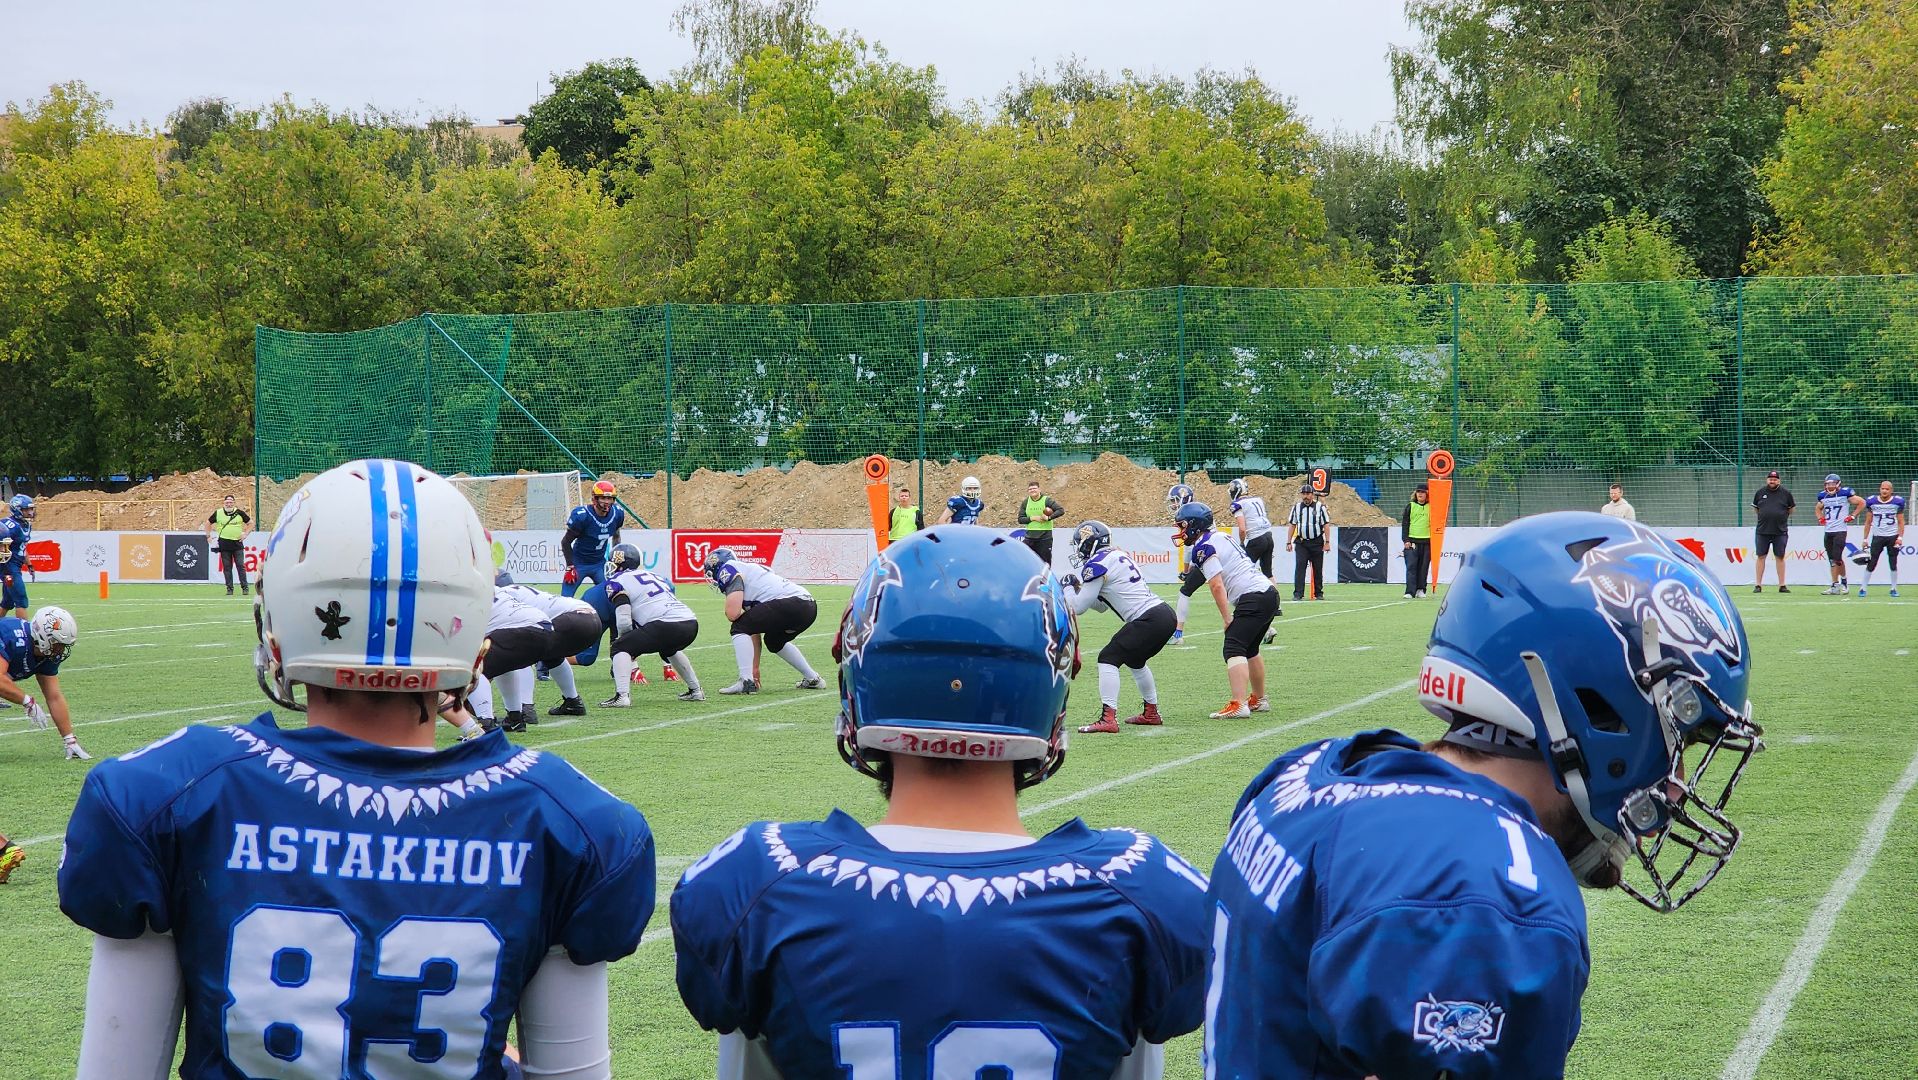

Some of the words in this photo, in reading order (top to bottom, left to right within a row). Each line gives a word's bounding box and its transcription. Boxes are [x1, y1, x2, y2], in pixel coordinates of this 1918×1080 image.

[1312, 468, 1327, 491] 3
[1872, 512, 1896, 527] 75
[595, 533, 610, 550] 7
[1351, 558, 1379, 570] КОРИЦА
[1360, 550, 1371, 560] &
[335, 667, 440, 690] Riddell
[225, 820, 533, 888] ASTAKHOV
[1495, 815, 1540, 893] 1
[223, 904, 506, 1080] 83
